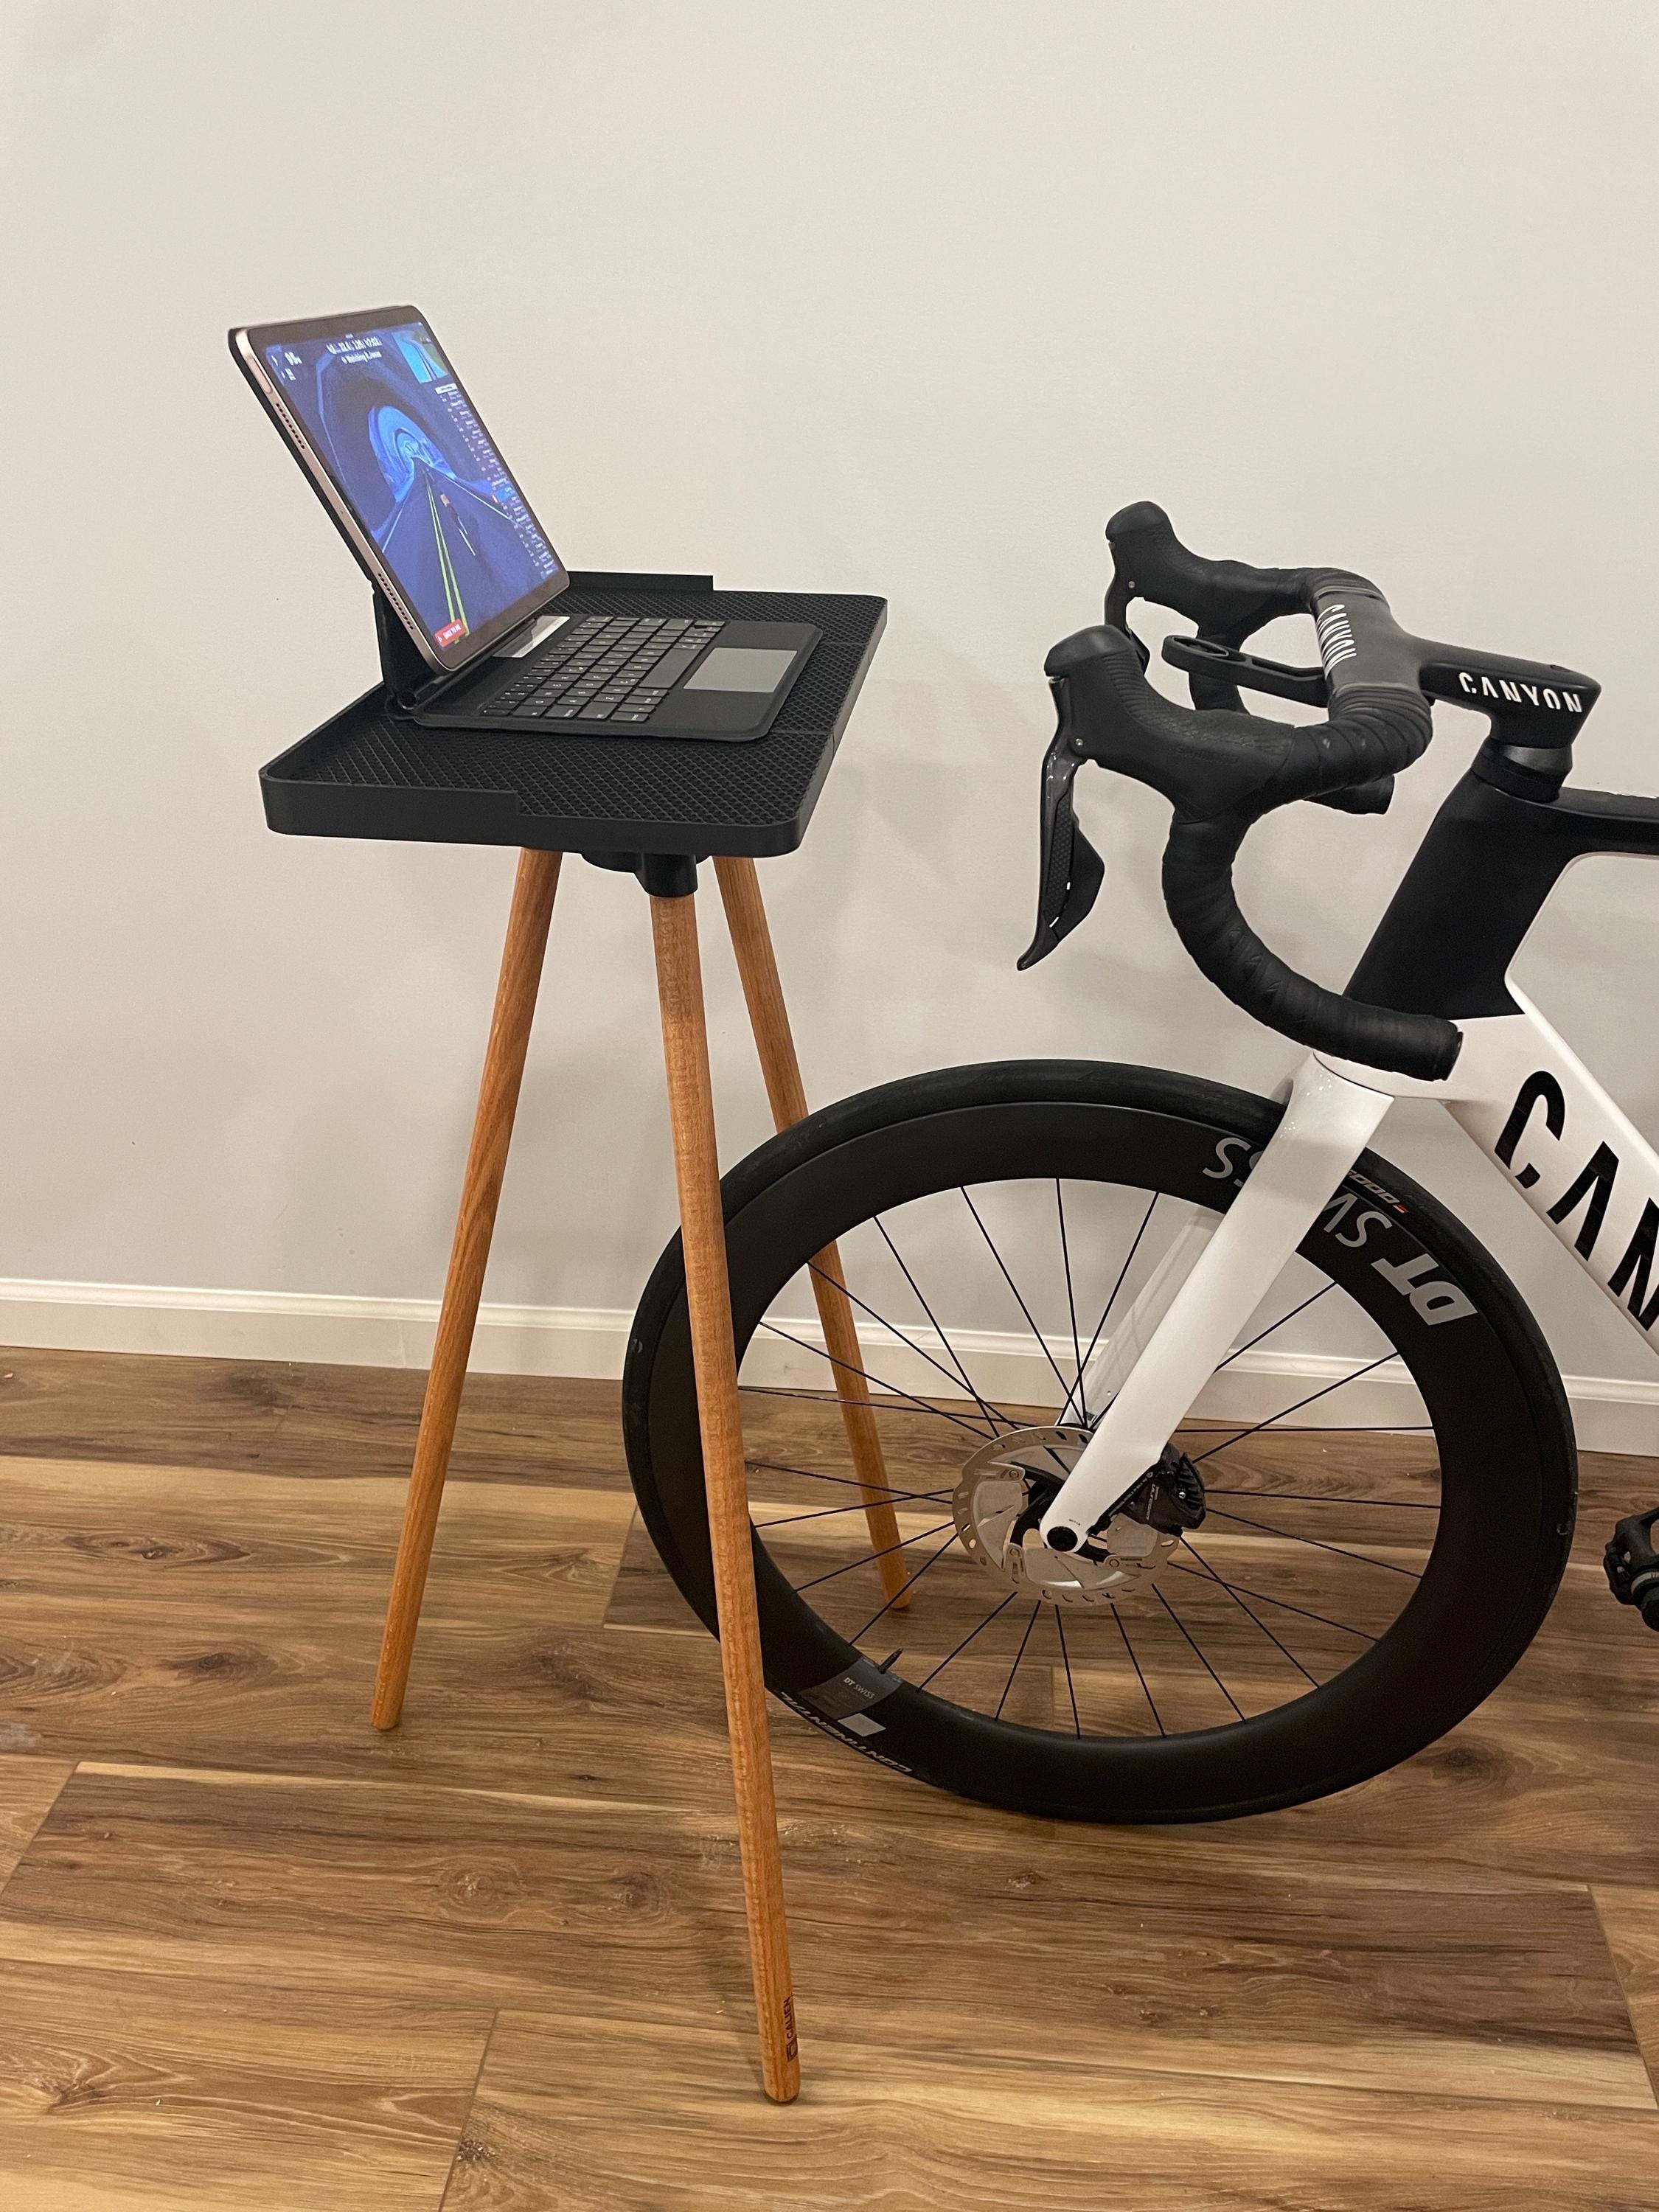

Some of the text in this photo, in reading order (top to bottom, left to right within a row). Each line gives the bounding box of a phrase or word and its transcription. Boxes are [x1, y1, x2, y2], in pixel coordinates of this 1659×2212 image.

[1458, 672, 1582, 712] CANYON
[1203, 1137, 1478, 1326] DT SWS
[1495, 1071, 1659, 1331] CAN
[843, 1677, 876, 1700] DT SWISS
[780, 1691, 914, 1773] CONTINENTAL
